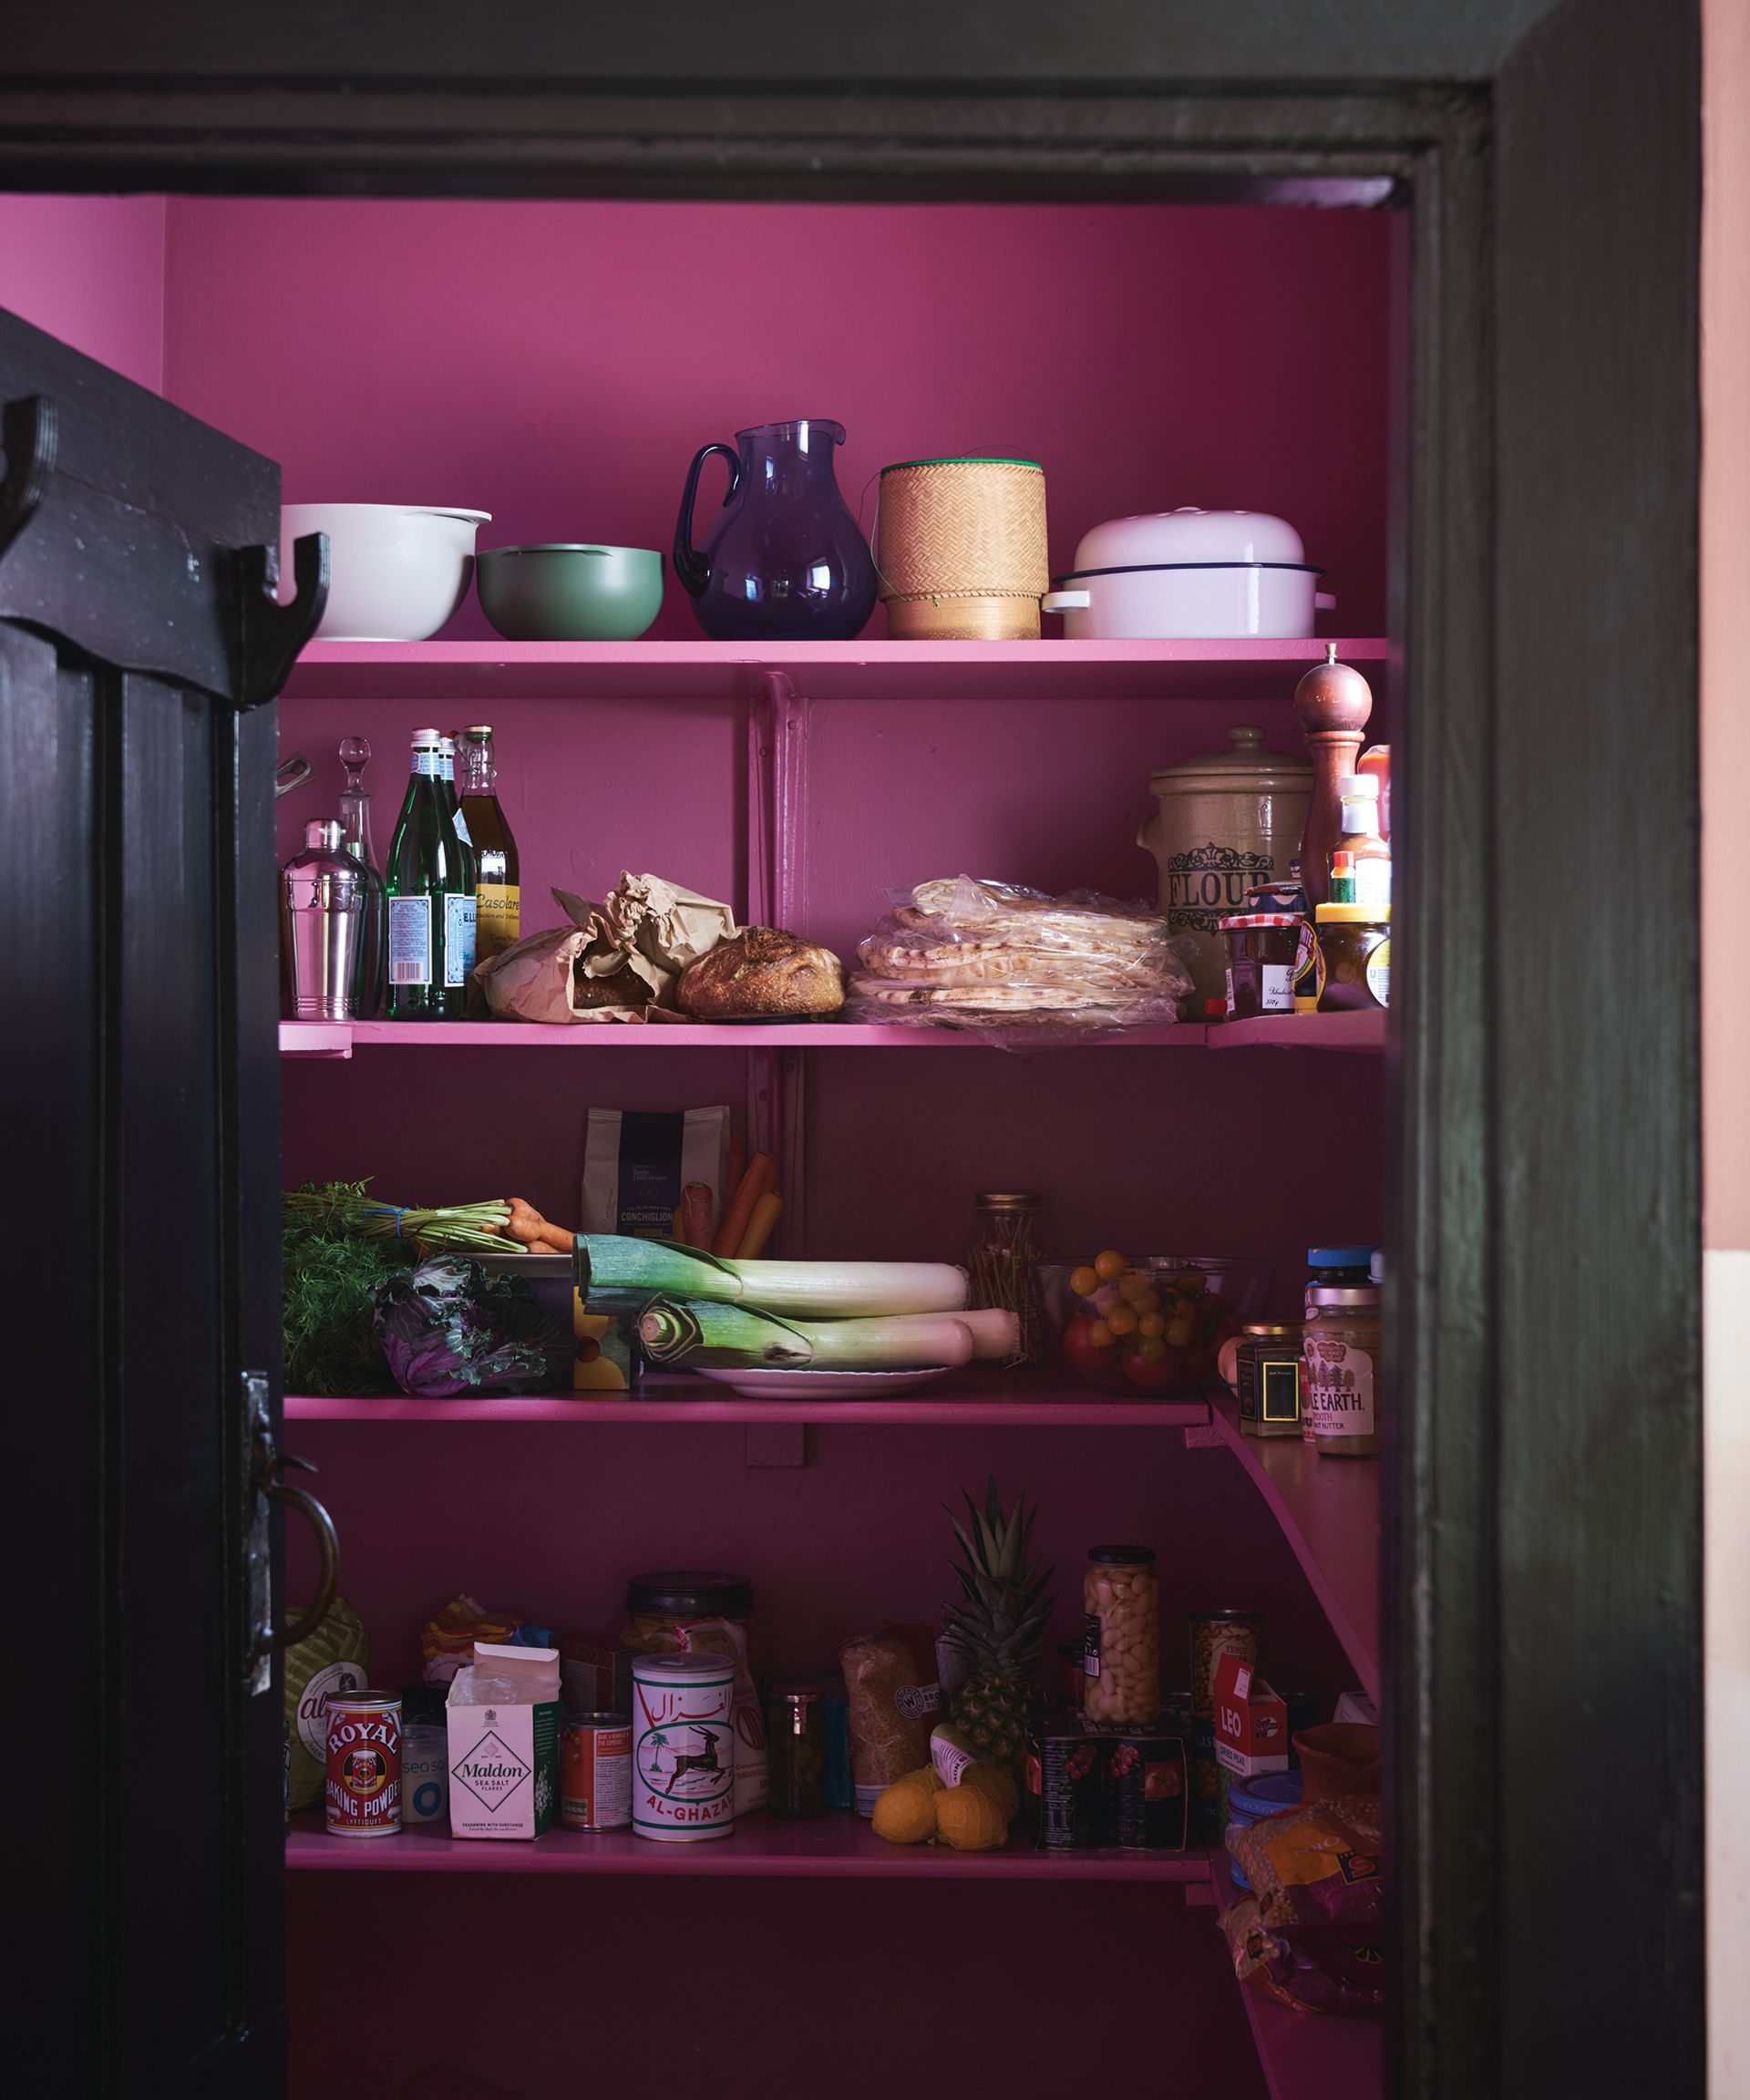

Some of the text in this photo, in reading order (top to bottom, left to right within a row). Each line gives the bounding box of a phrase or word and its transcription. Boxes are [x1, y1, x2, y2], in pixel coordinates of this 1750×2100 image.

[477, 893, 520, 911] Casolare
[1220, 1705, 1241, 1738] LEO
[327, 1722, 398, 1756] ROYAL
[462, 1763, 523, 1778] Maldon
